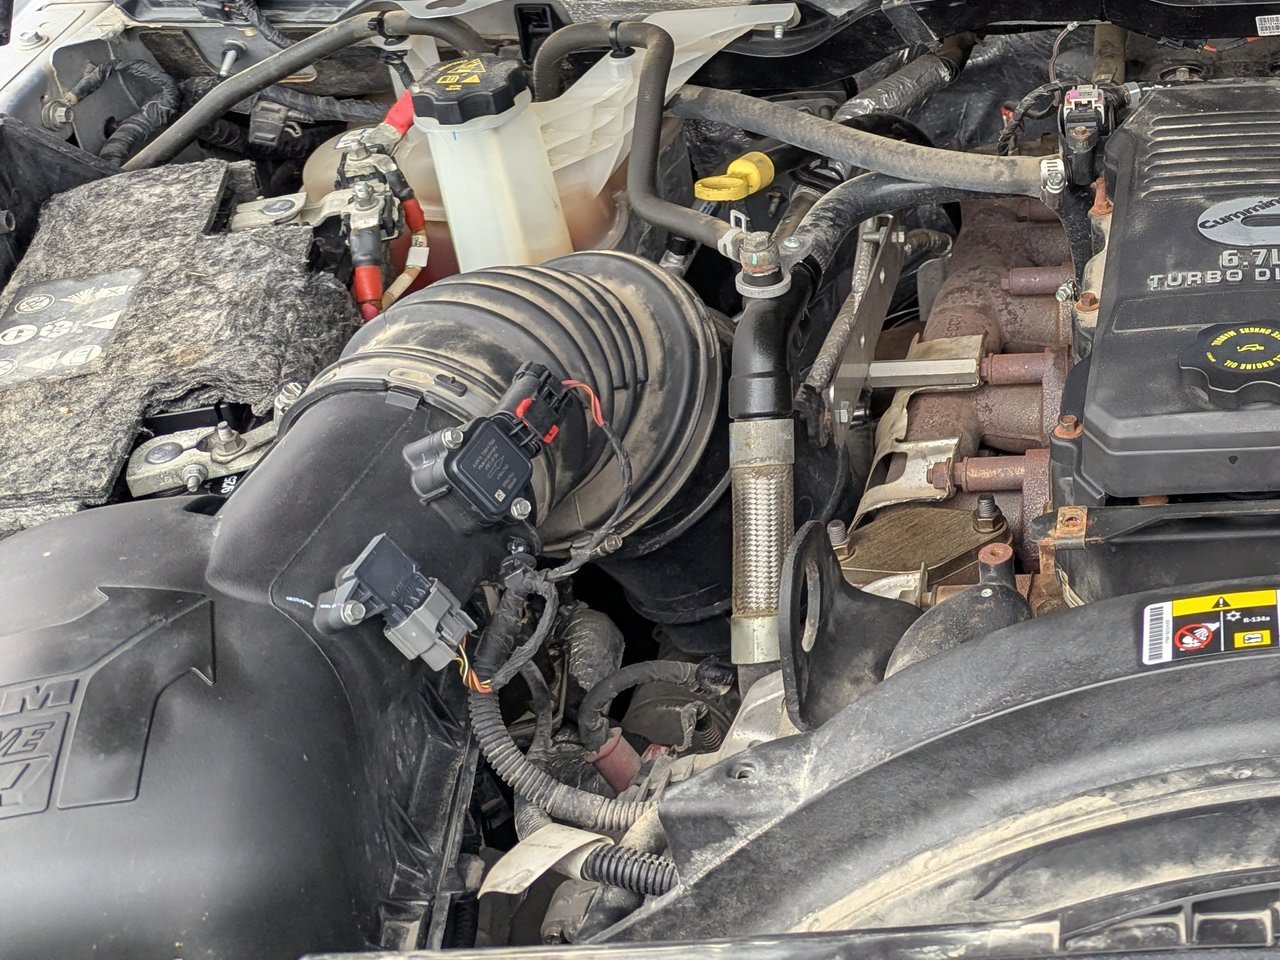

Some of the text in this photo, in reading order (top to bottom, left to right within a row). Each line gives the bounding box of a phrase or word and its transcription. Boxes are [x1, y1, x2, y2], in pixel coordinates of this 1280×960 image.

[1149, 269, 1244, 288] TURBO
[1223, 359, 1239, 369] OIL
[1239, 359, 1275, 370] ENGINE
[1242, 615, 1271, 623] R-134a
